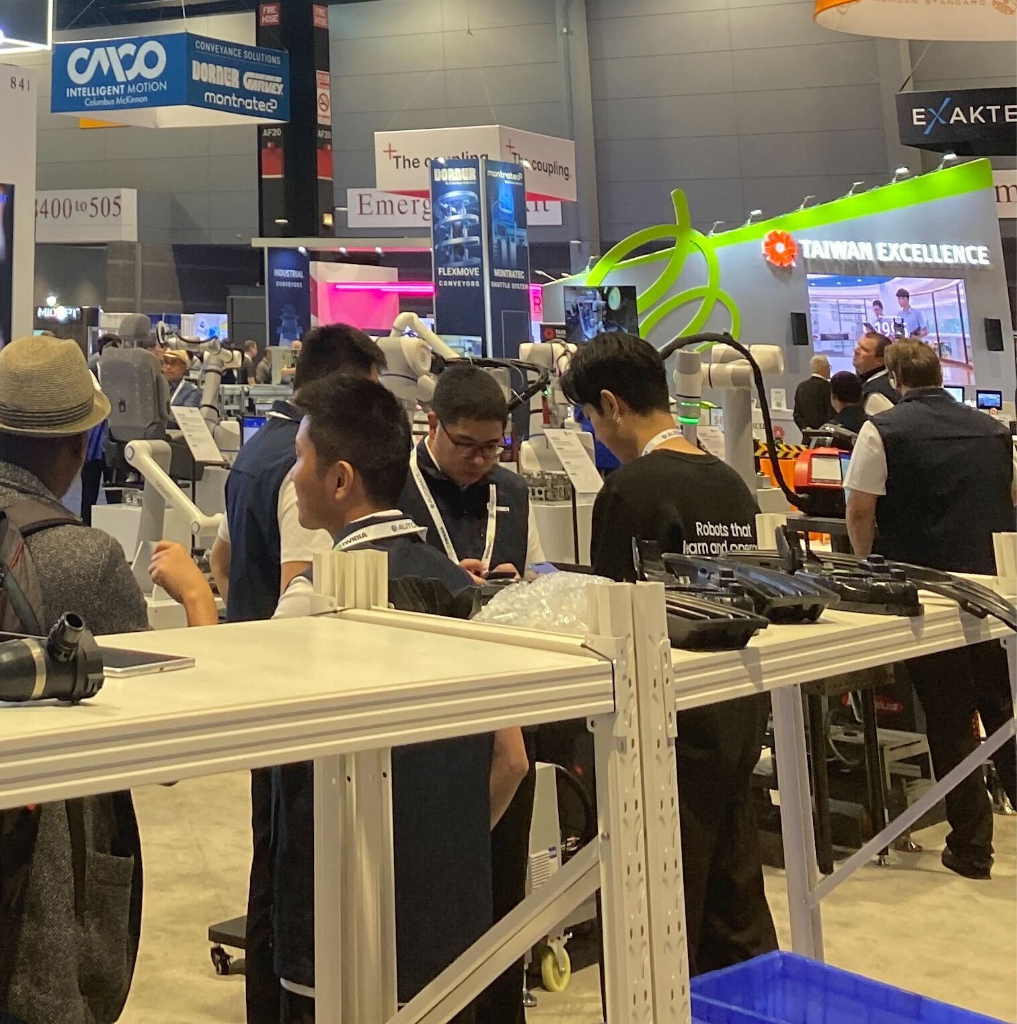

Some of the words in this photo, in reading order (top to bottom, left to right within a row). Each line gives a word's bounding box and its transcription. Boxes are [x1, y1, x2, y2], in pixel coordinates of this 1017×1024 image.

[195, 39, 243, 59] CONVEYANCE
[243, 49, 281, 65] SOLUTIONS
[191, 59, 240, 89] DORNER
[10, 76, 31, 92] 841
[66, 84, 125, 98] INTELLIGENT
[126, 81, 167, 95] MOTION
[84, 96, 115, 107] Columbus
[116, 95, 148, 106] McKinnon
[204, 90, 278, 113] montratec
[912, 97, 1017, 135] EXAKTE
[262, 127, 281, 137] AF20
[392, 154, 420, 170] The
[531, 157, 572, 181] coupling.
[434, 168, 477, 182] DORNER
[75, 200, 87, 212] to
[89, 195, 122, 218] 505
[357, 193, 431, 220] Emerg
[799, 240, 874, 261] TAIWAN
[876, 242, 990, 265] EXCELLENCE
[438, 267, 480, 276] FLEXMOVE
[695, 521, 729, 537] Robots
[730, 522, 752, 538] that
[683, 539, 709, 555] larn
[710, 539, 728, 555] and
